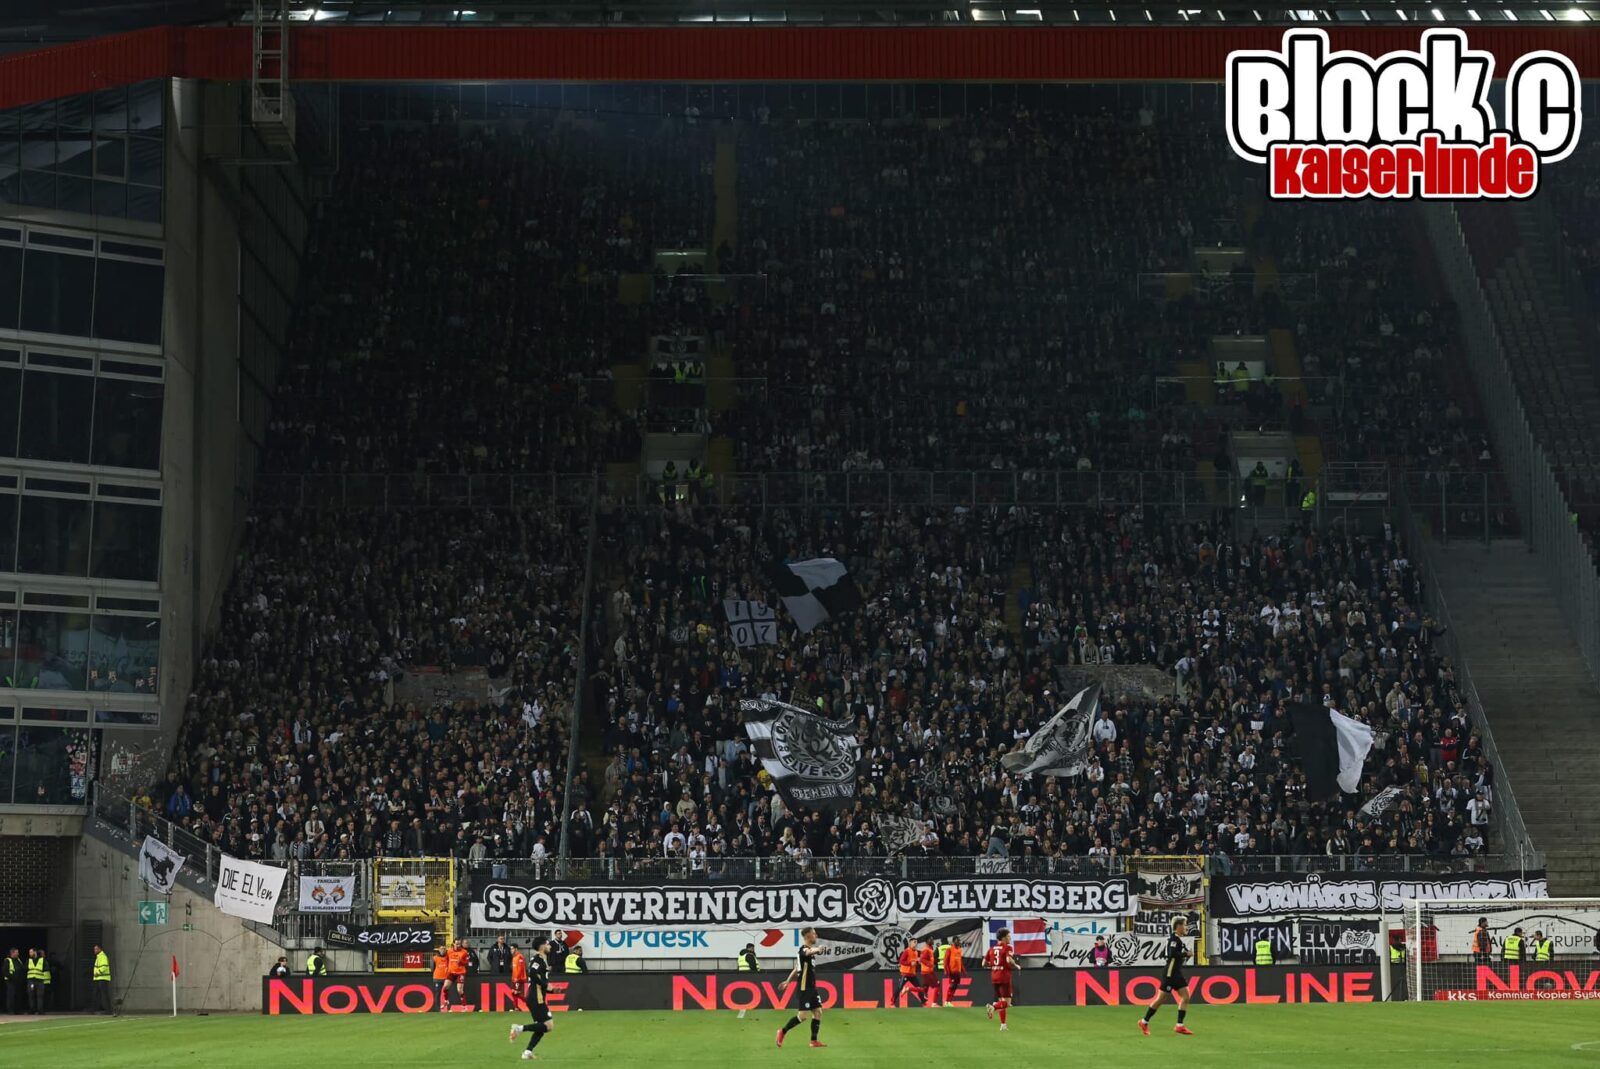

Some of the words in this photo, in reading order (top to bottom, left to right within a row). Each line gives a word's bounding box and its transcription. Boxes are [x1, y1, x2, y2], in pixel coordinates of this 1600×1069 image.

[222, 867, 241, 891] DIE
[488, 888, 843, 920] SPORTVEREINIGUNG
[898, 885, 932, 910] 07
[941, 883, 1125, 911] ELVERSBERG
[1227, 875, 1377, 913] VORWÄRTS
[1300, 924, 1341, 947] ELV
[1547, 936, 1597, 948] RUPP
[834, 945, 866, 956] Besten
[994, 949, 1000, 966] 3
[1448, 990, 1477, 1000] kks
